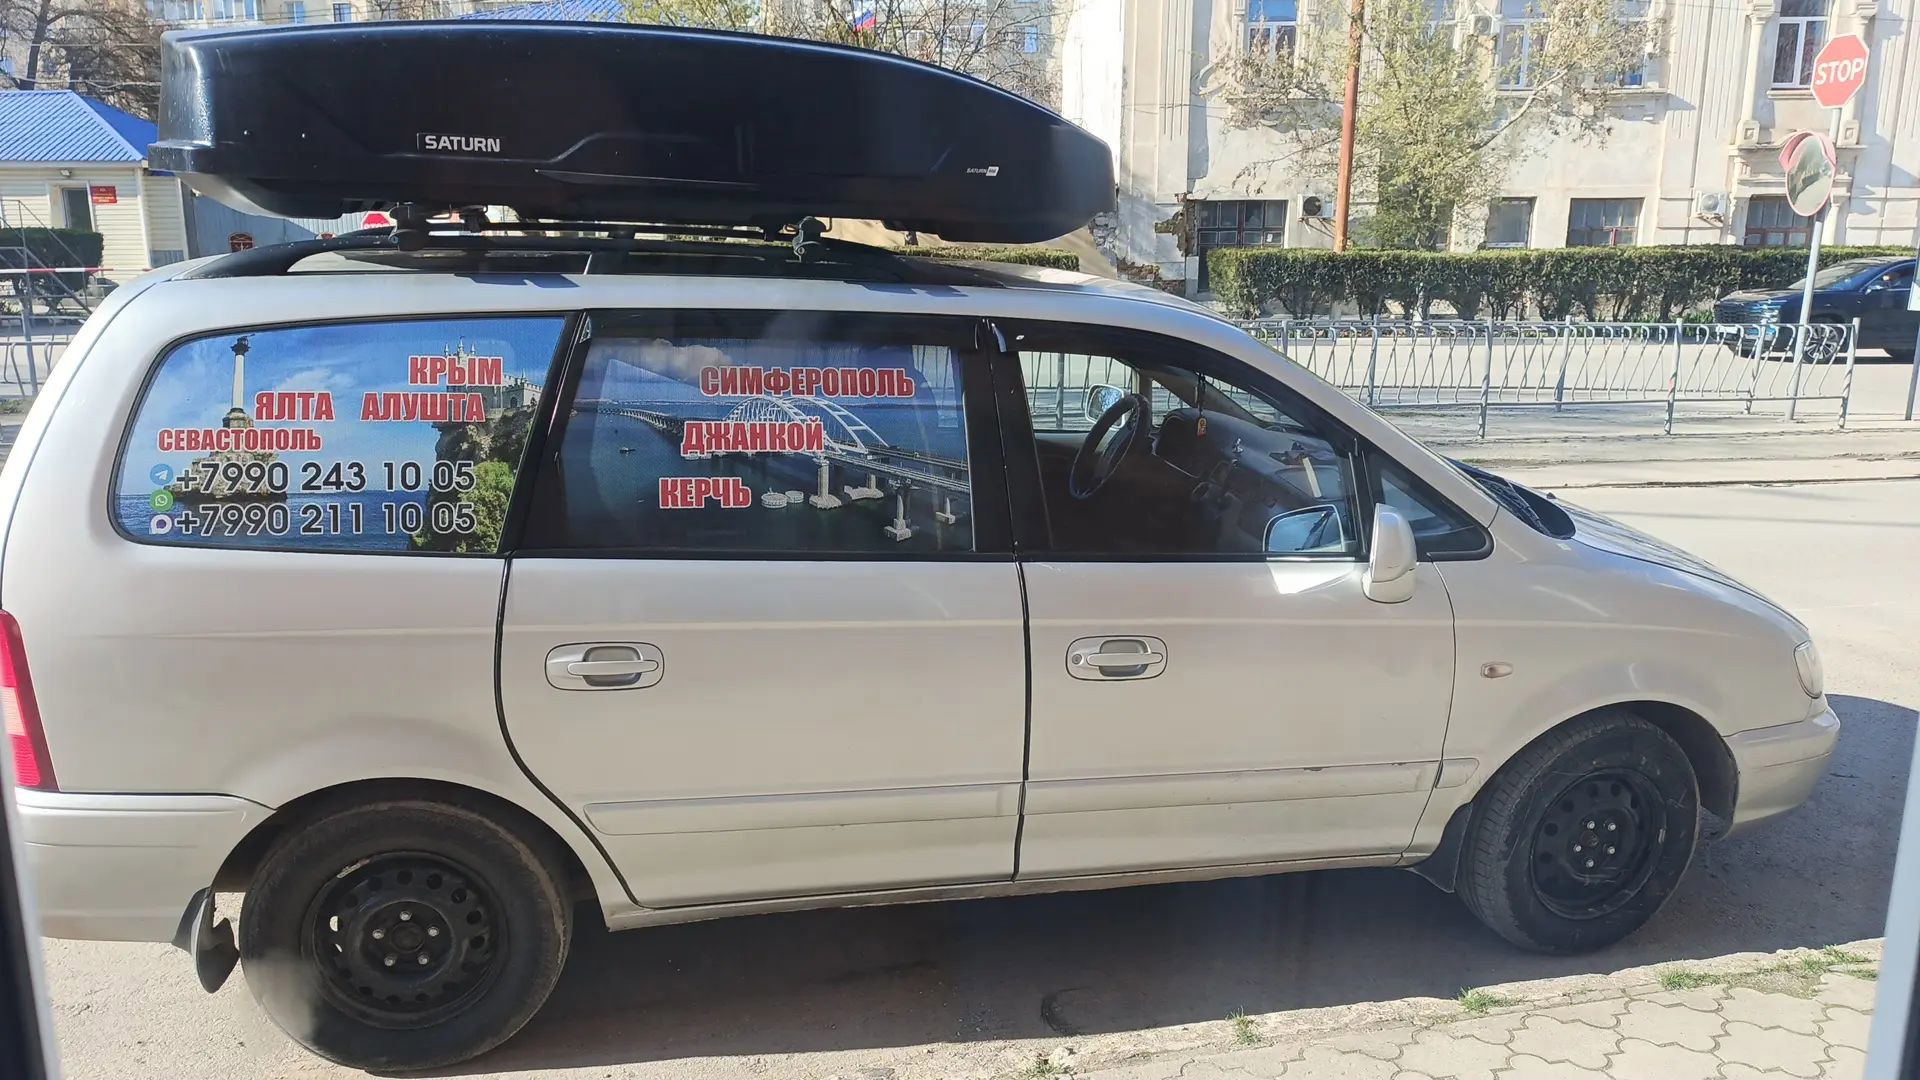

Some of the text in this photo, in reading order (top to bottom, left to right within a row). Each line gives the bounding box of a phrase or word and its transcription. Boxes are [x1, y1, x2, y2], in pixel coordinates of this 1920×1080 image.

[1815, 57, 1865, 86] STOP
[424, 135, 501, 152] SATURN
[408, 355, 503, 387] КРЫМ
[700, 366, 915, 397] СИМФЕРОПОЛЬ
[255, 391, 486, 422] ЯЛТА АЛУШТА
[157, 427, 322, 452] СЕВАСТОПОЛЬ
[681, 416, 826, 455] ДЖАНКОЙ
[176, 460, 476, 493] +7990 243 10 05
[658, 477, 752, 509] КЕРЧЬ
[176, 502, 476, 536] +7990 211 10 05
